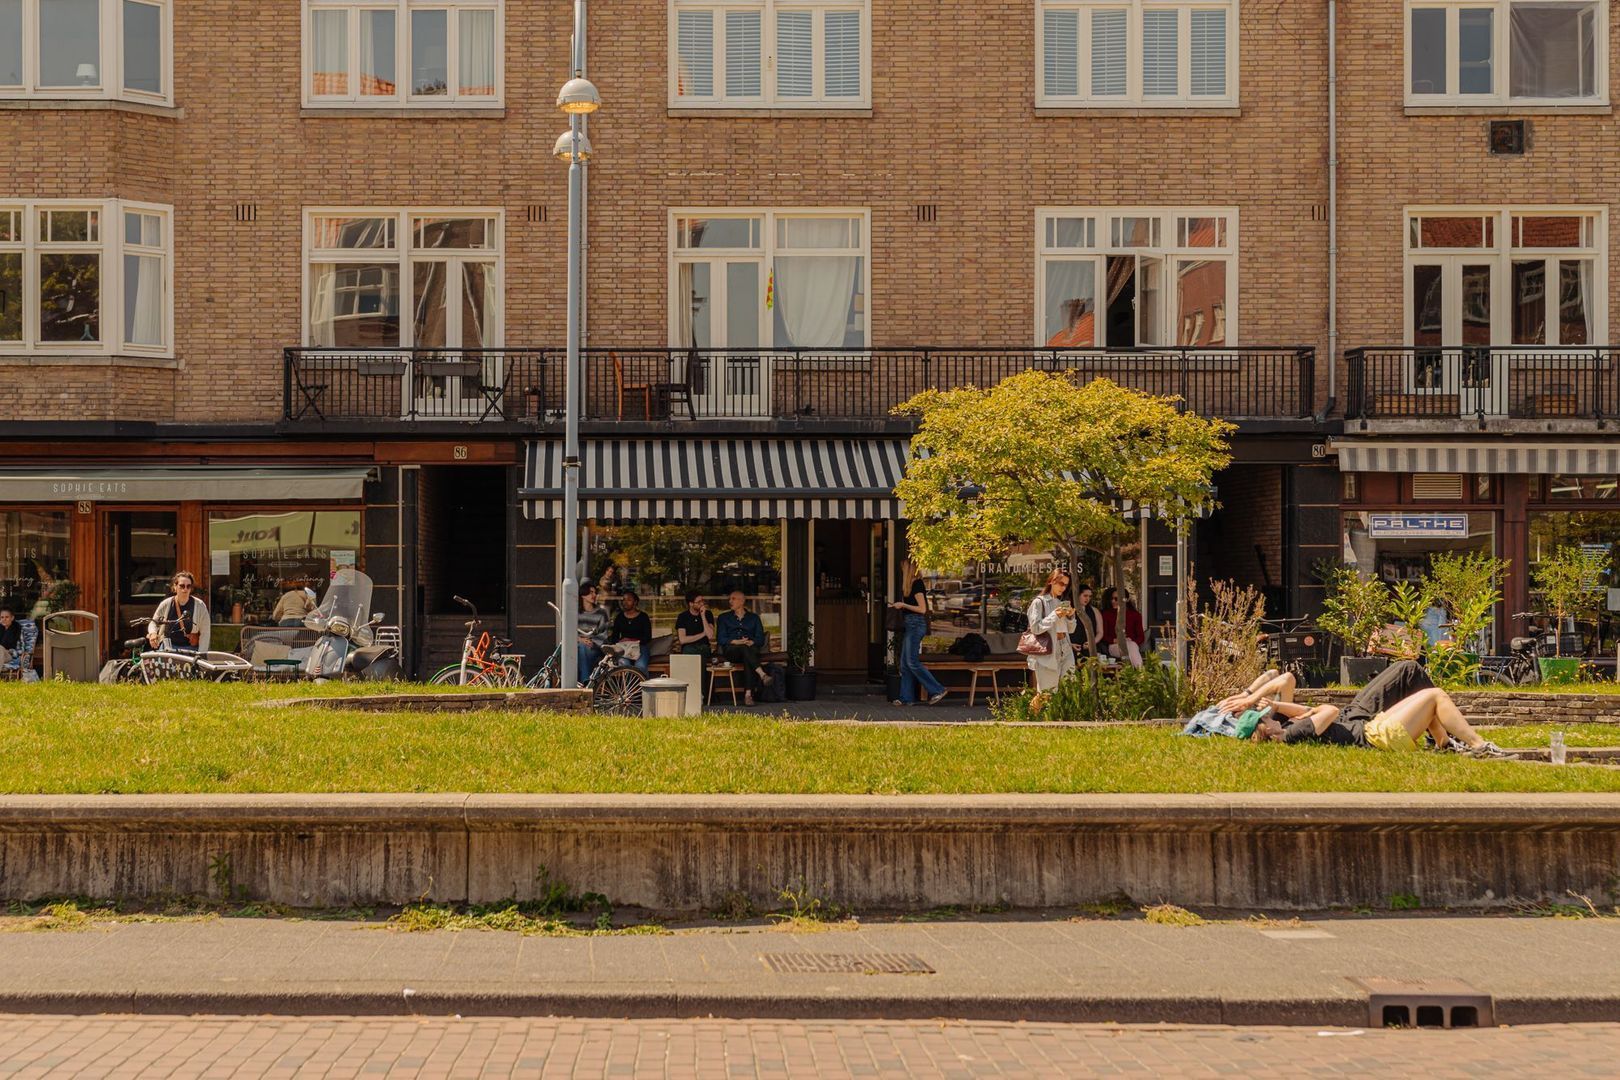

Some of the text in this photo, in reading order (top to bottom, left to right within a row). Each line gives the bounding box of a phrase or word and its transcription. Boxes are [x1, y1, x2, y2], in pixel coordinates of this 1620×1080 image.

[455, 447, 467, 458] 86
[1313, 445, 1325, 457] 80
[53, 482, 127, 493] SOPHIE EATS
[79, 501, 91, 513] 88
[1374, 520, 1463, 528] PALTHE
[6, 547, 37, 559] EATS
[242, 548, 289, 559] SOPHIE
[296, 548, 327, 559] EATS
